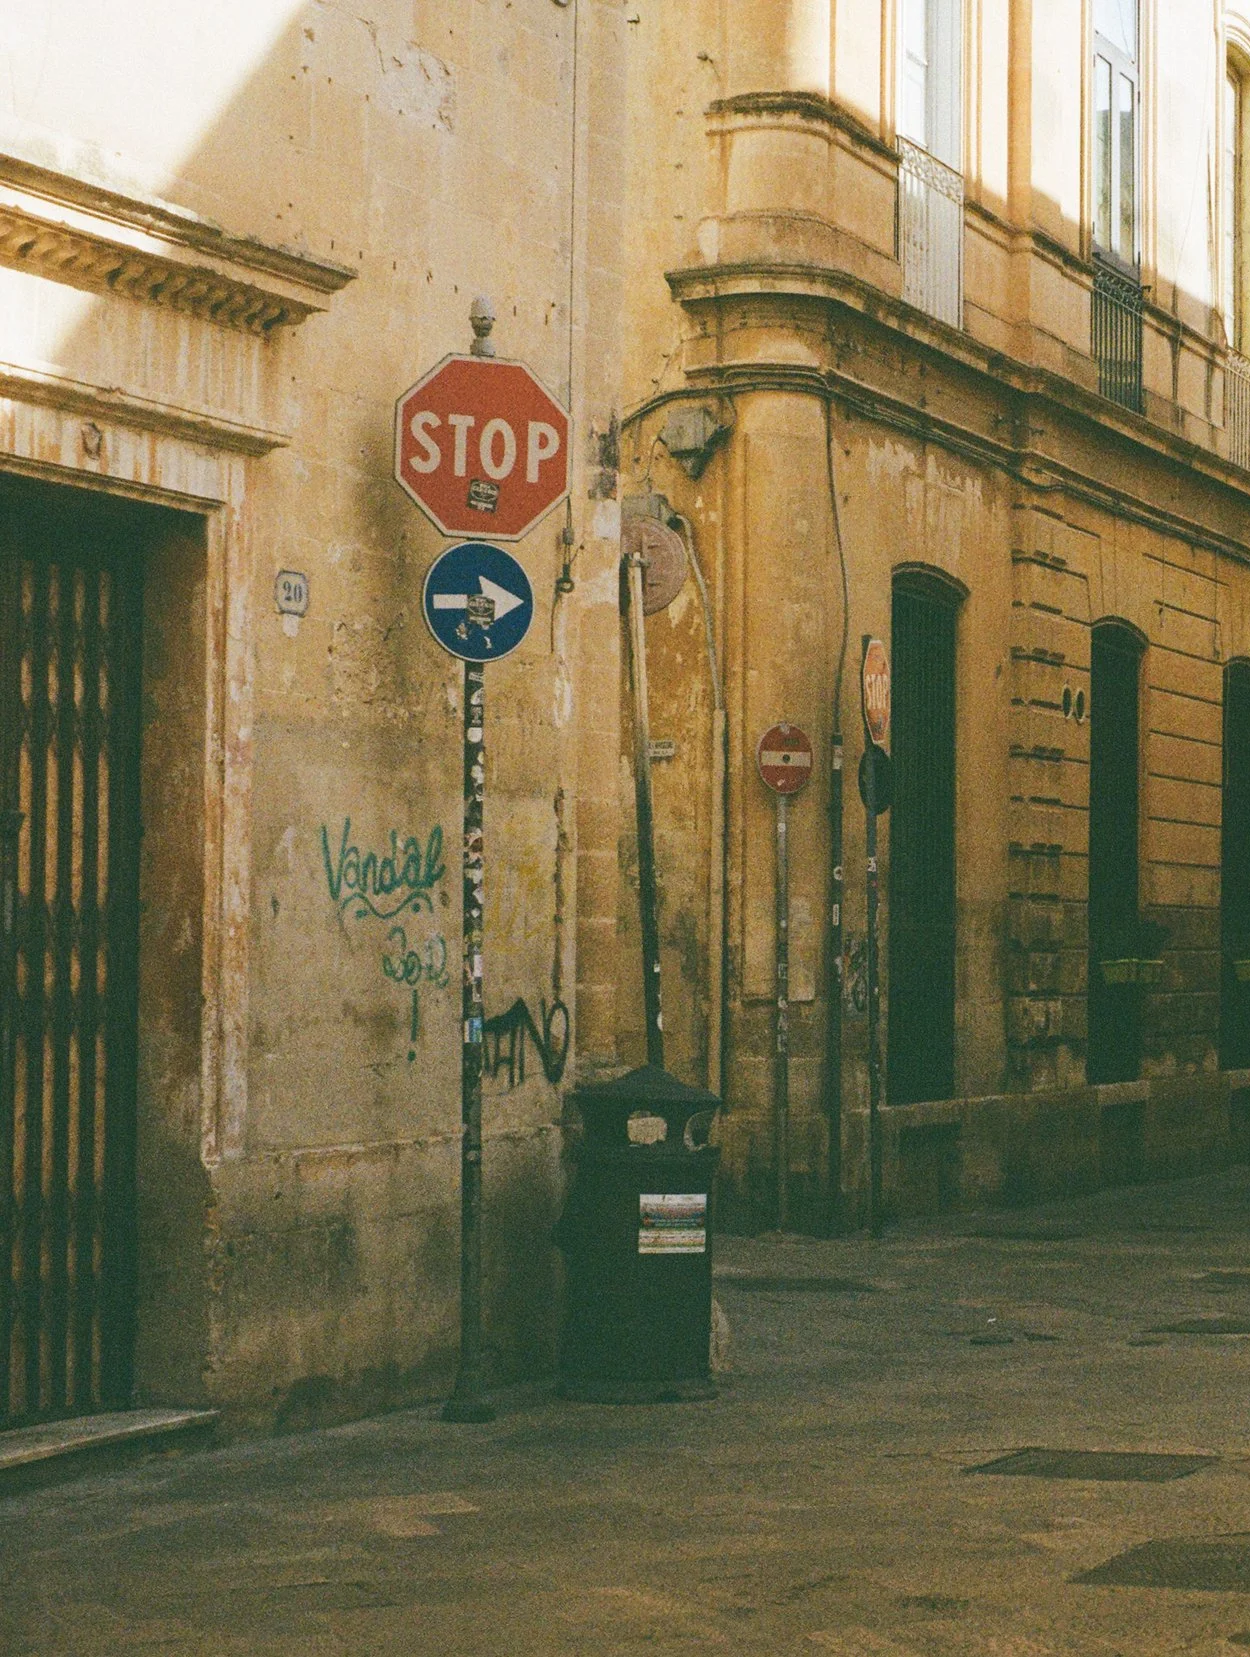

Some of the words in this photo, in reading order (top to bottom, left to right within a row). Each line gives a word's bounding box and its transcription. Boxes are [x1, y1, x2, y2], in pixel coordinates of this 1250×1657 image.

[409, 410, 560, 483] STOP
[283, 580, 302, 603] 20
[321, 817, 447, 900] Vandal
